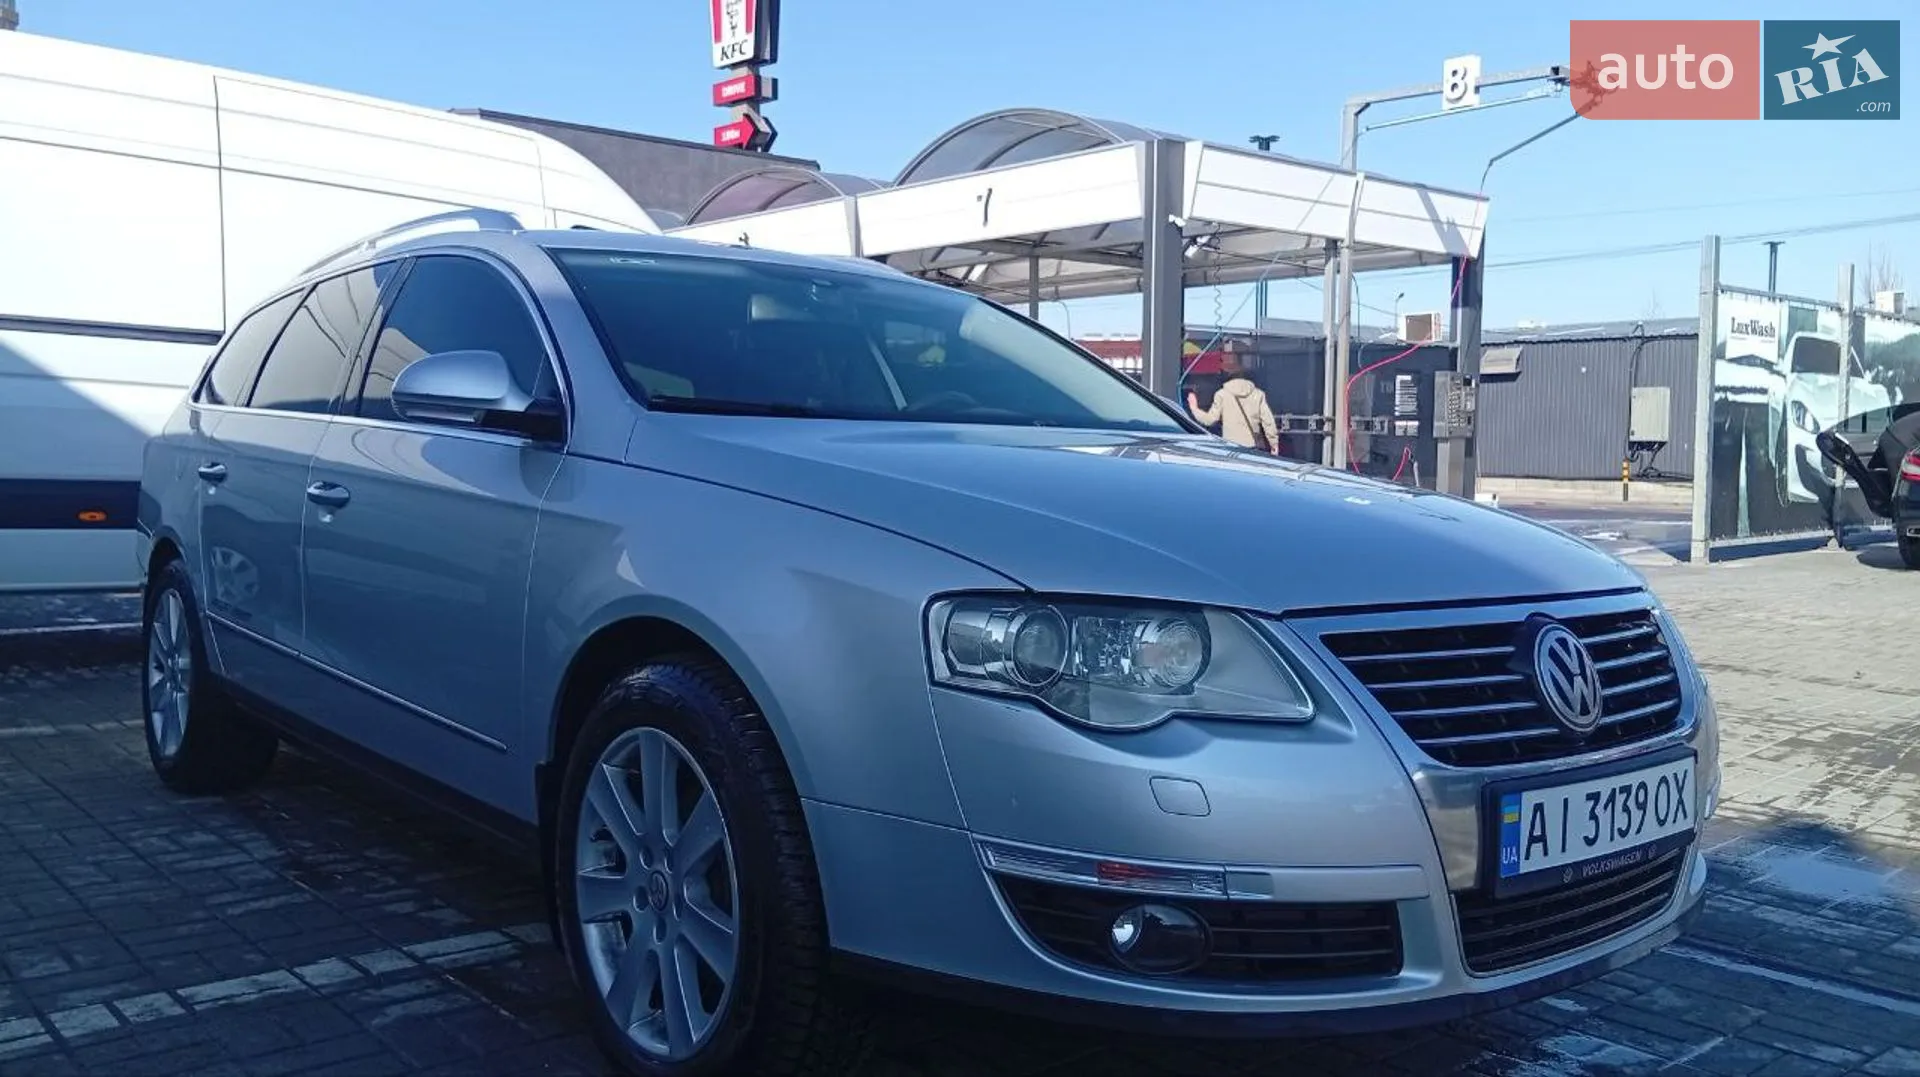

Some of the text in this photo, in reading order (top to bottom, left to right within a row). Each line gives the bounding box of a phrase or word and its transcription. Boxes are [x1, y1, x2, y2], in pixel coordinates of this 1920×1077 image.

[720, 39, 748, 61] KFC
[1731, 316, 1776, 339] LuxWash
[1502, 847, 1518, 864] UA
[1582, 849, 1642, 877] VOLKSWAGEN
